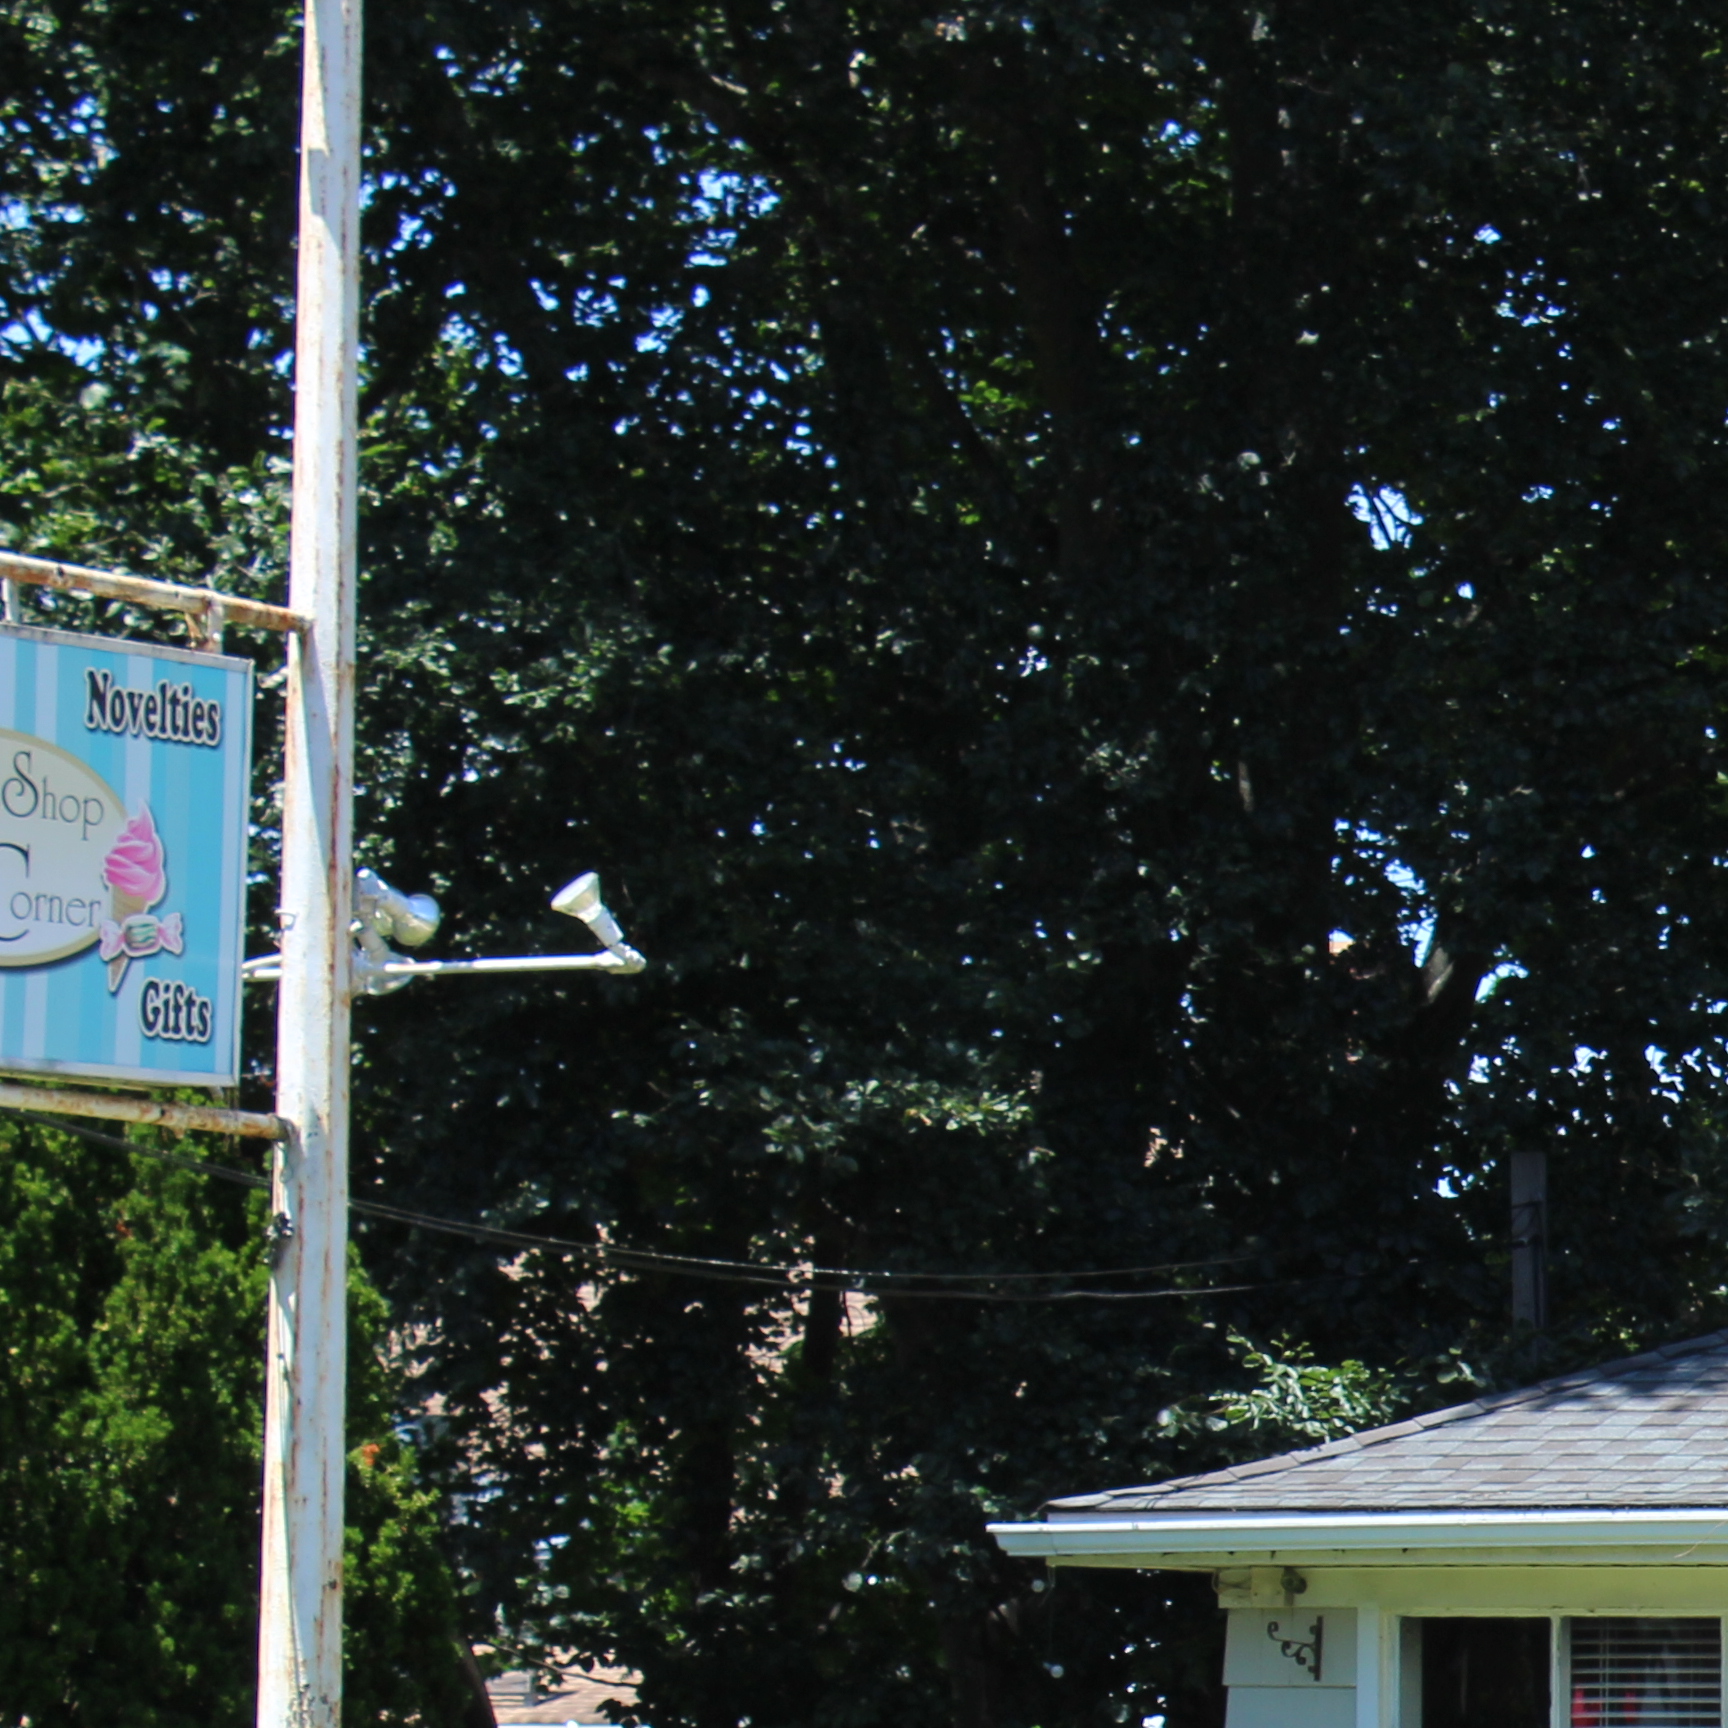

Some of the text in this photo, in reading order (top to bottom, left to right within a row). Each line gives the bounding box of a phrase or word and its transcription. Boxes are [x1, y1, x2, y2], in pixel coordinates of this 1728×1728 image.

[86, 669, 220, 745] Novelties
[1, 750, 104, 841] Shop
[140, 978, 211, 1041] Gifts
